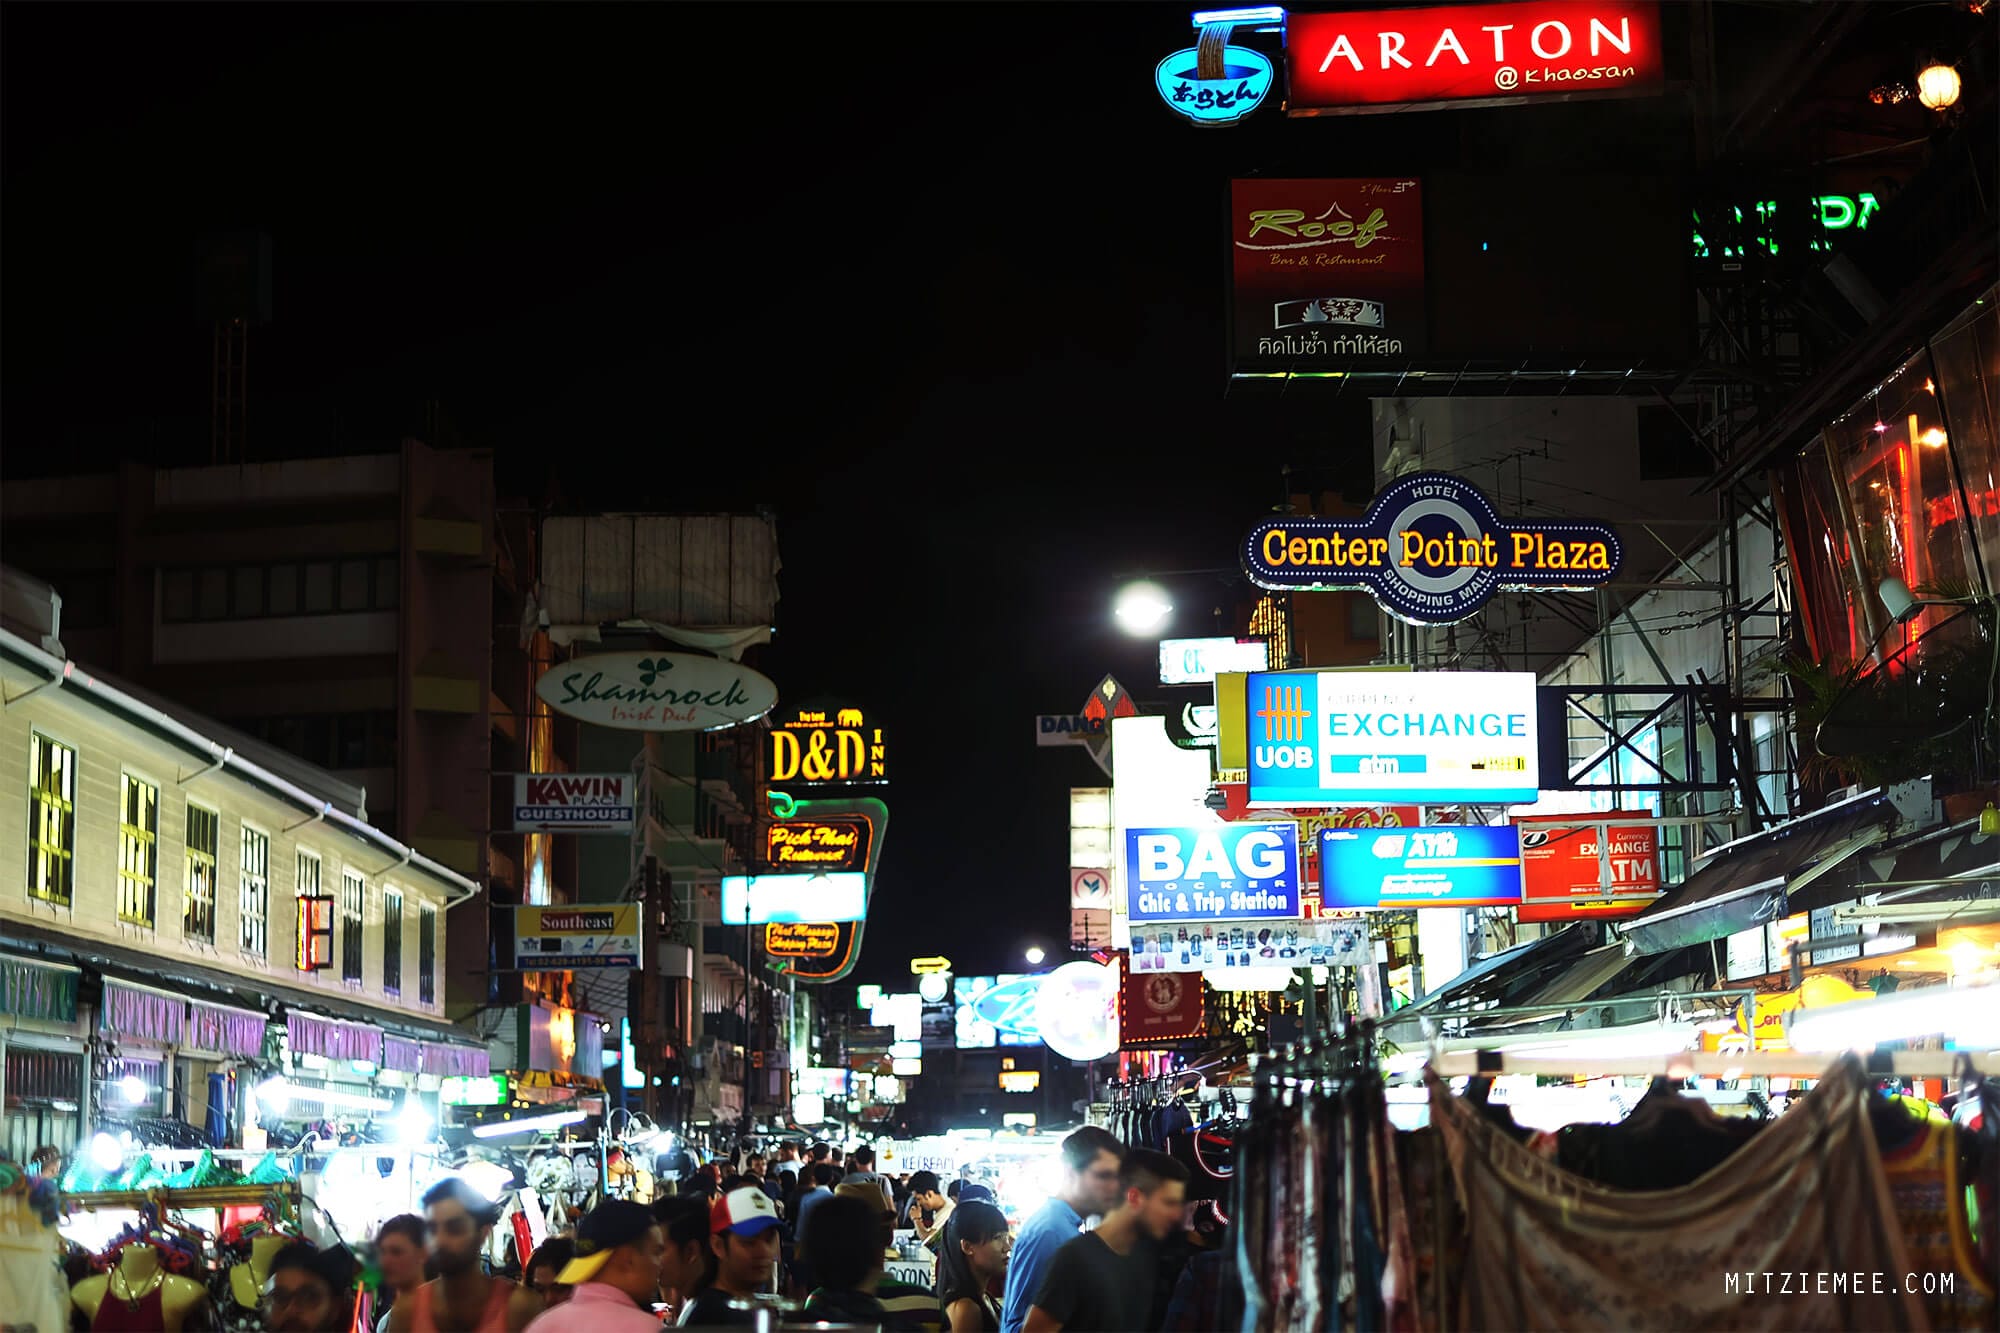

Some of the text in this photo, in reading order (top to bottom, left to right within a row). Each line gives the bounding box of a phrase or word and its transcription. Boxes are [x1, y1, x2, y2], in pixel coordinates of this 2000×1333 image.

[1318, 17, 1632, 73] ARATON
[1269, 252, 1386, 267] Bar & Restaurant
[1411, 485, 1460, 501] HOTEL
[1262, 529, 1611, 570] Center Point Plaza
[1382, 567, 1494, 608] SHOPPING MALL
[559, 672, 750, 707] Shamrock
[611, 705, 697, 723] Irish Pub
[1328, 713, 1527, 738] EXCHANGE
[769, 728, 886, 782] D&D INN
[1255, 745, 1314, 769] UOB
[526, 777, 623, 806] KAWIN
[573, 796, 622, 806] PLACE
[518, 808, 630, 821] GUESTHOUSE
[1408, 835, 1459, 858] ATM
[1580, 841, 1651, 857] EXHANGE
[1617, 832, 1651, 844] Currency
[1137, 830, 1286, 882] BAG
[1139, 880, 1286, 891] LOCKER
[1138, 891, 1170, 914] Chic
[1174, 892, 1190, 913] &
[1193, 889, 1225, 916] Trip
[1230, 888, 1288, 911] Station
[541, 914, 615, 930] Southeast
